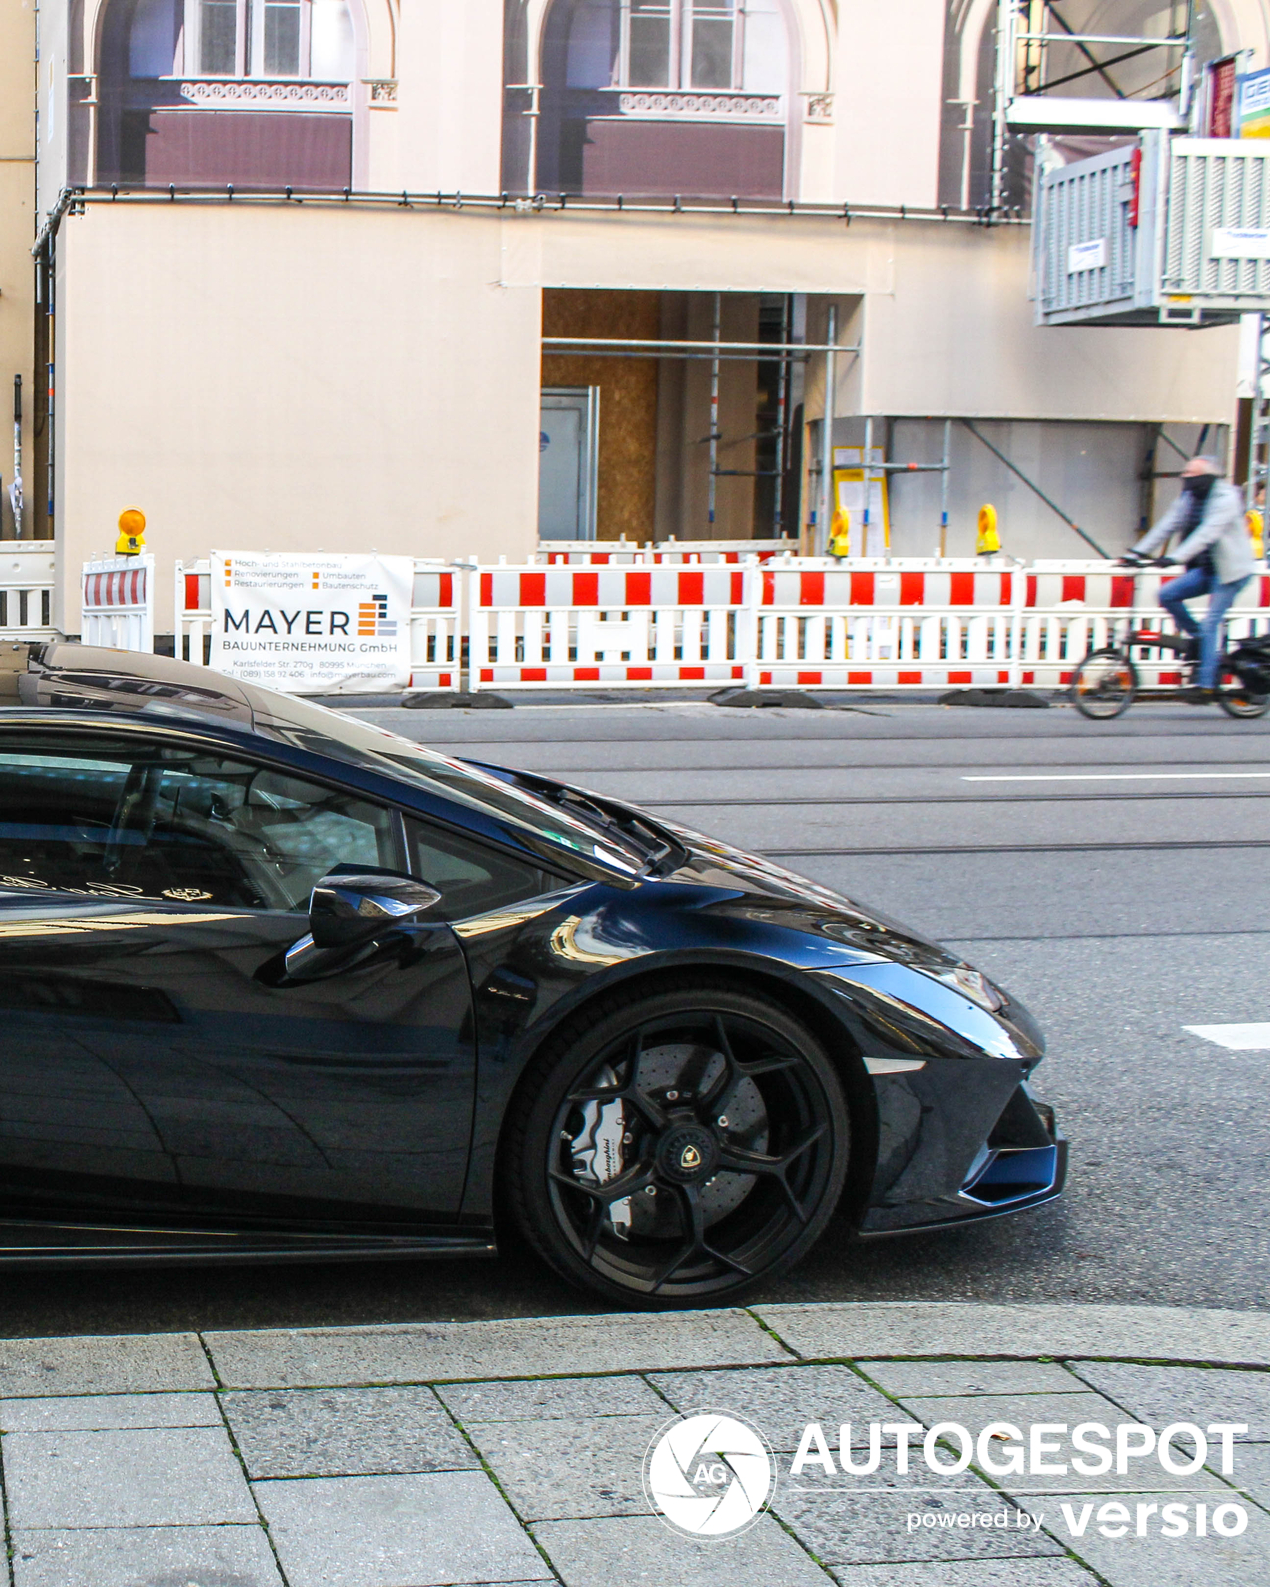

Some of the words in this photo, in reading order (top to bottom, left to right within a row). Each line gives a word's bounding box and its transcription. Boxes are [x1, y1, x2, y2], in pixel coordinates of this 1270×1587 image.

[234, 559, 260, 567] Hoch-
[281, 561, 343, 570] Stahlbetonbau
[234, 570, 299, 579] Renovierungen
[322, 572, 367, 580] Umbauten
[233, 580, 304, 590] Restaurierungen
[322, 582, 379, 591] Bautenschutz
[223, 608, 350, 636] MAYER
[222, 641, 356, 653] BAUUNTERNEHMUNG
[359, 643, 398, 653] GmbH
[233, 660, 276, 668] Karlsfelder
[278, 660, 292, 668] Str.
[293, 661, 314, 670] 270g
[319, 661, 345, 669] 80995
[239, 670, 262, 679] (089)
